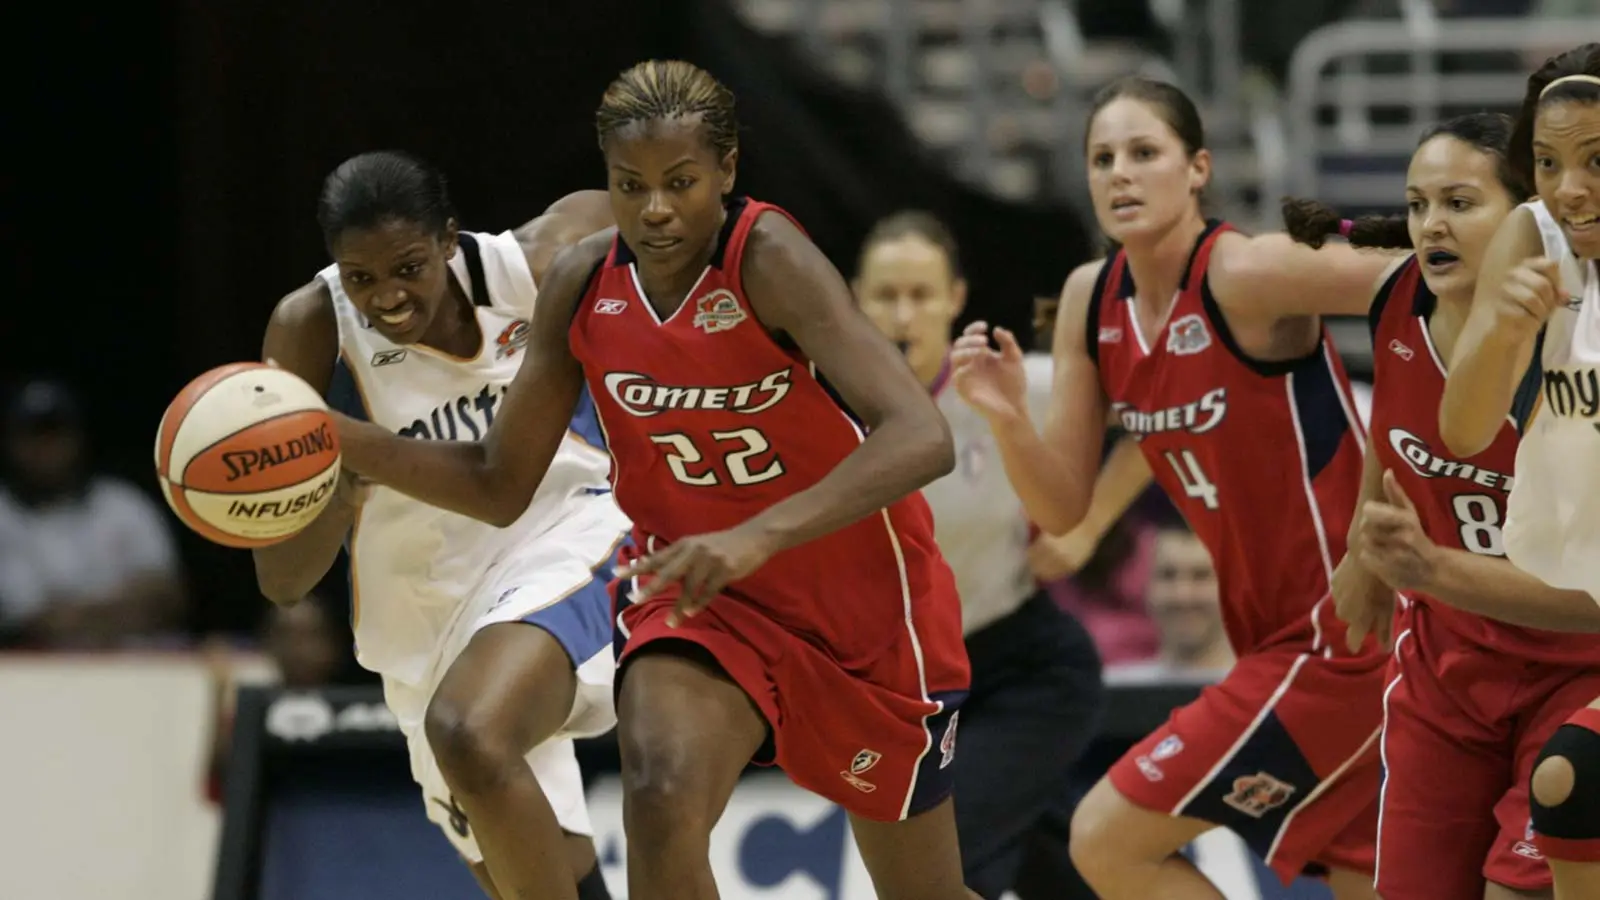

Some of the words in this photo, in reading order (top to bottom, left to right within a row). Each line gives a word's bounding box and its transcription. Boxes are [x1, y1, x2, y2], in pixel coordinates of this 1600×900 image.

[603, 366, 793, 418] COMETS
[221, 422, 334, 482] SPALDING
[648, 426, 786, 486] 22
[1163, 449, 1220, 510] 4
[1388, 428, 1516, 492] COMET
[1452, 493, 1507, 556] 8
